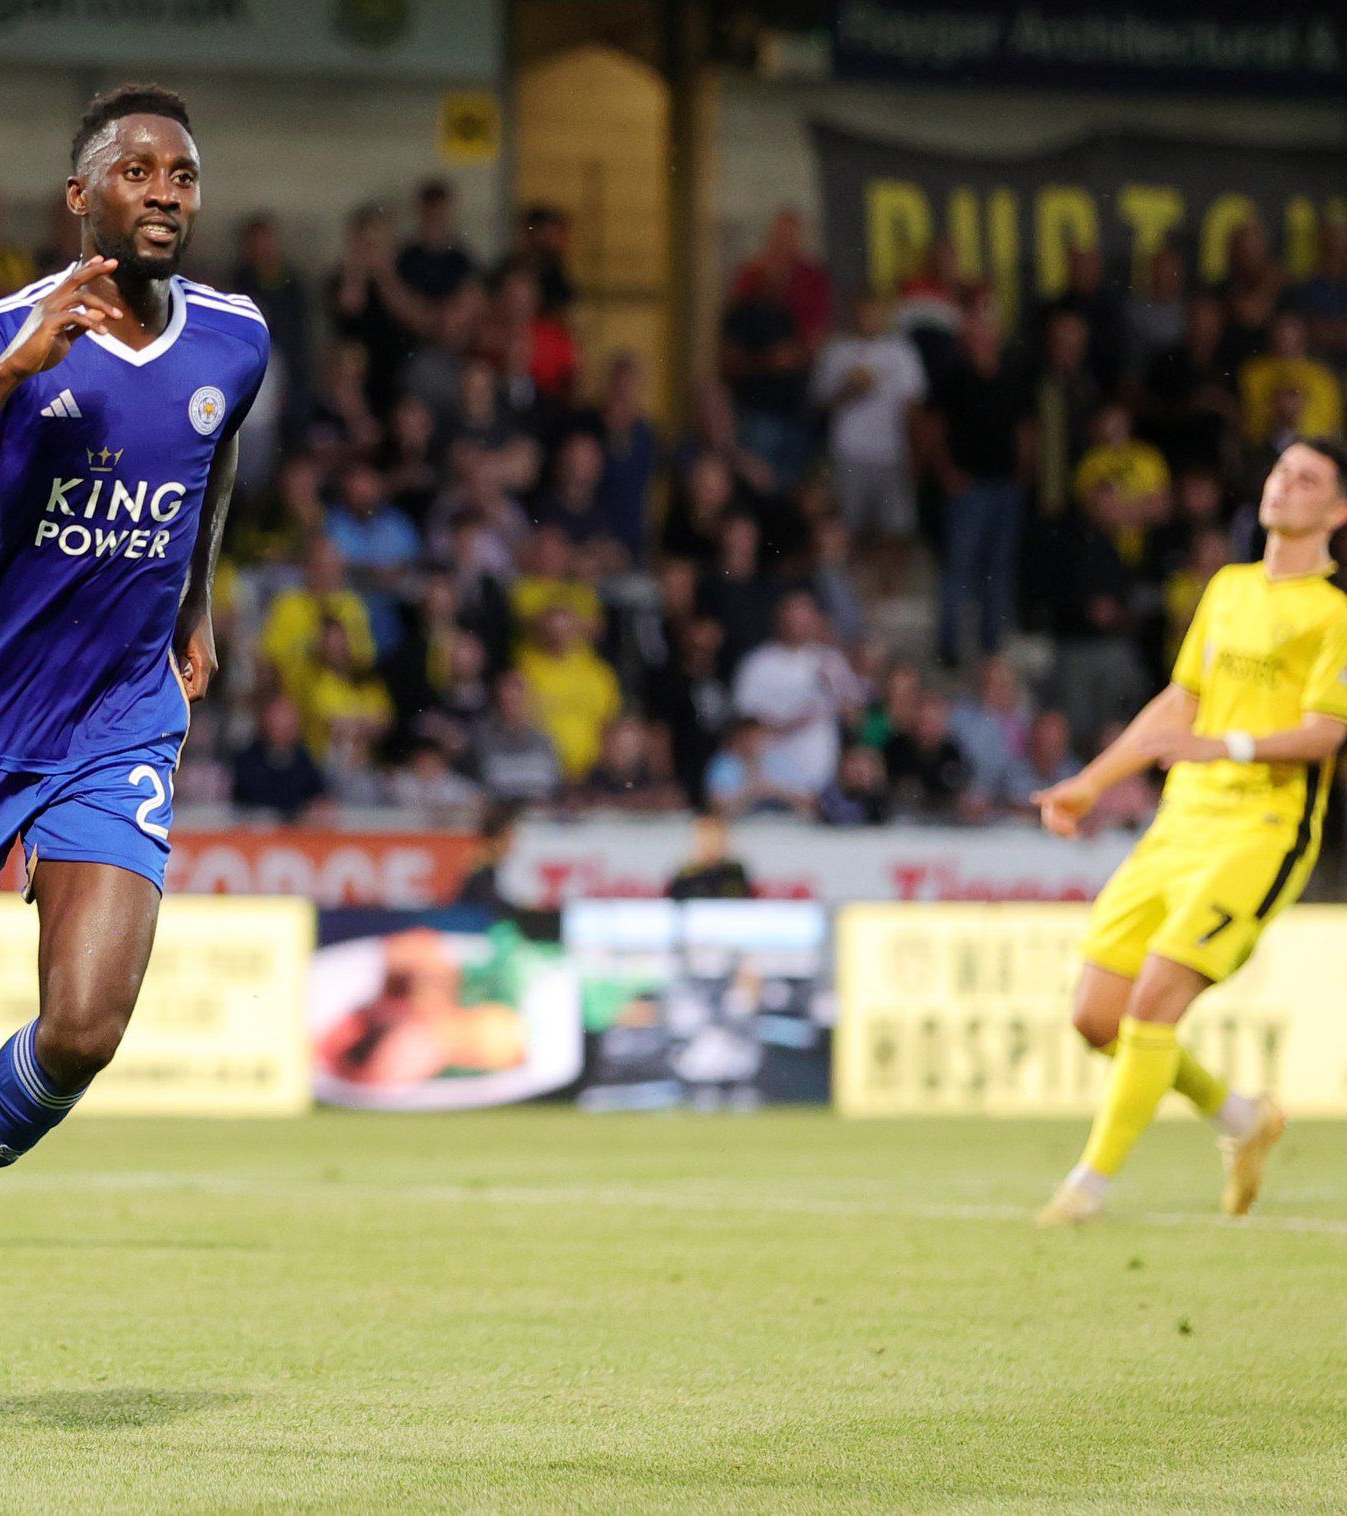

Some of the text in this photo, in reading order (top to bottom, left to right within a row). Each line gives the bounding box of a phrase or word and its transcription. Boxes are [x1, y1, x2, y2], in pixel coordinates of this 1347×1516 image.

[46, 477, 187, 523] KING
[34, 519, 170, 559] POWER
[128, 765, 169, 840] 2
[1199, 903, 1233, 945] 7
